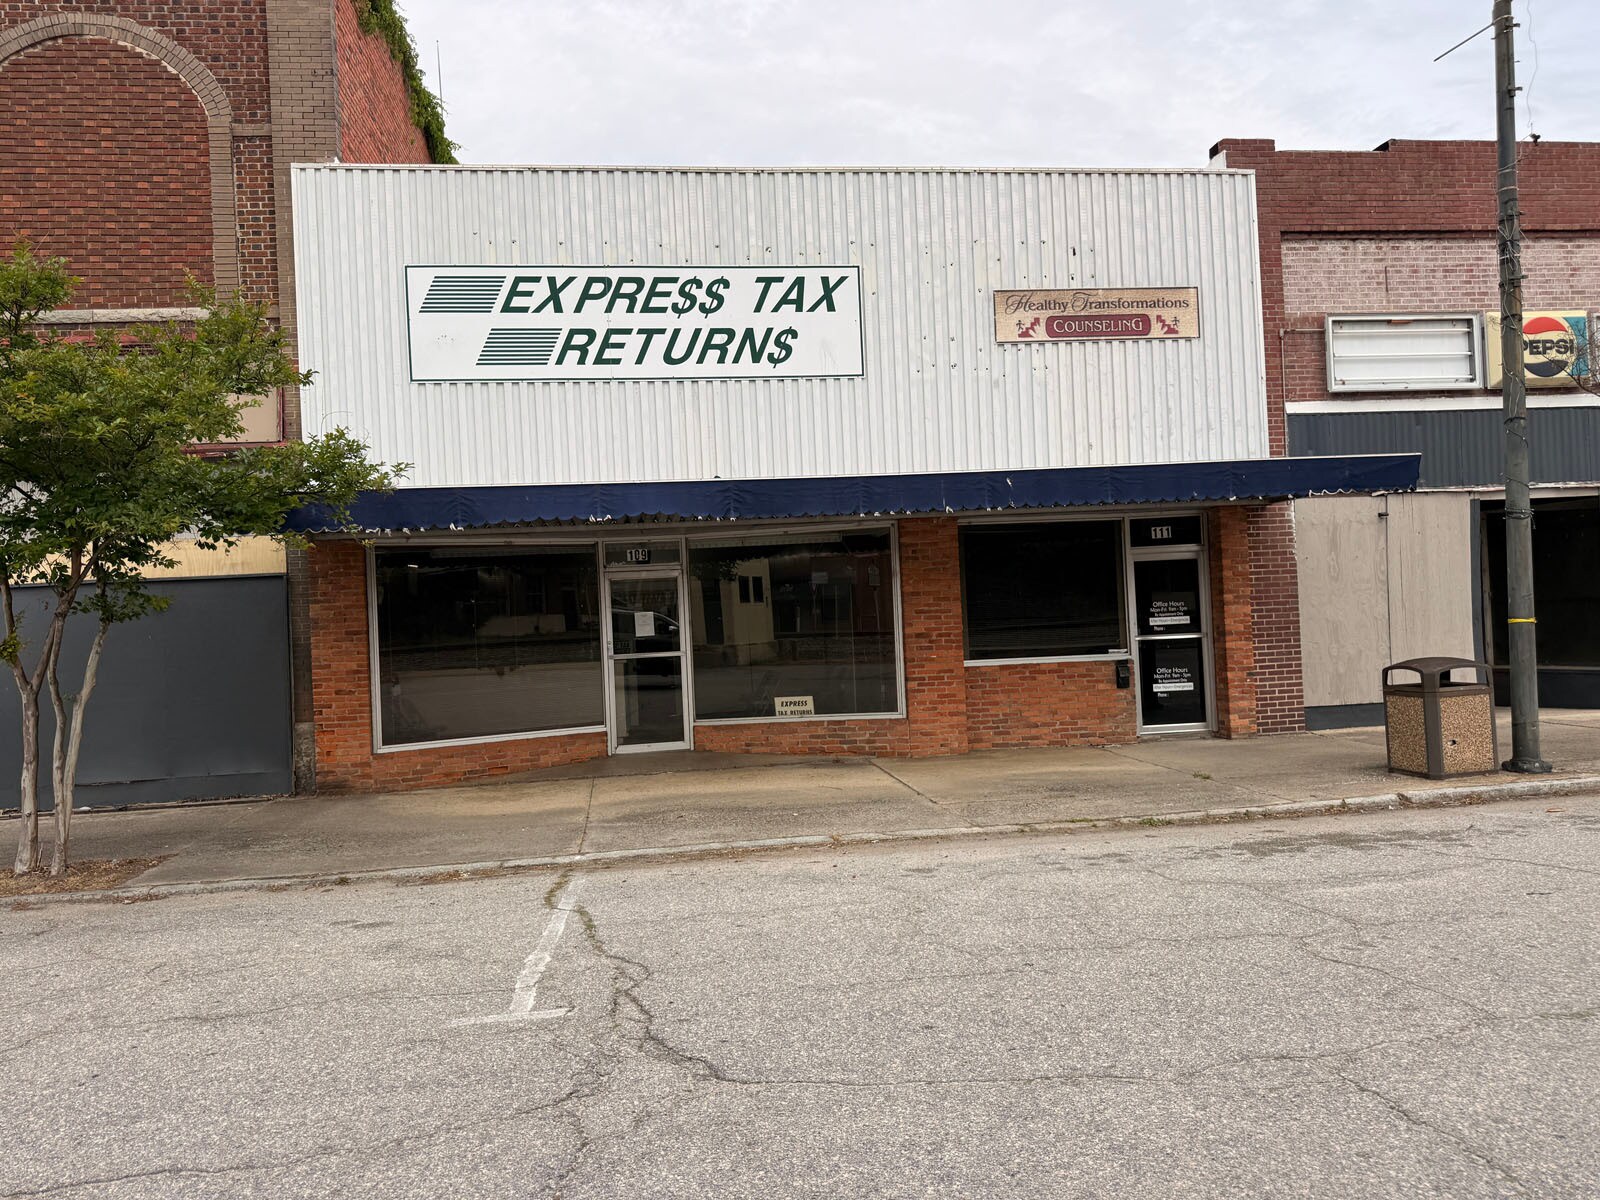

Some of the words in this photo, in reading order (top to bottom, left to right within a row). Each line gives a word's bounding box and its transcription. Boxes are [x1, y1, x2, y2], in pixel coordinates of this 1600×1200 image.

[500, 276, 730, 319] EXPRE$$
[753, 276, 849, 313] TAX
[1005, 292, 1069, 315] Healthy
[1071, 291, 1189, 312] Transformations
[1053, 318, 1143, 333] COUNSELING
[554, 326, 798, 369] RETURN$
[1152, 527, 1170, 538] 111
[628, 549, 647, 561] 109
